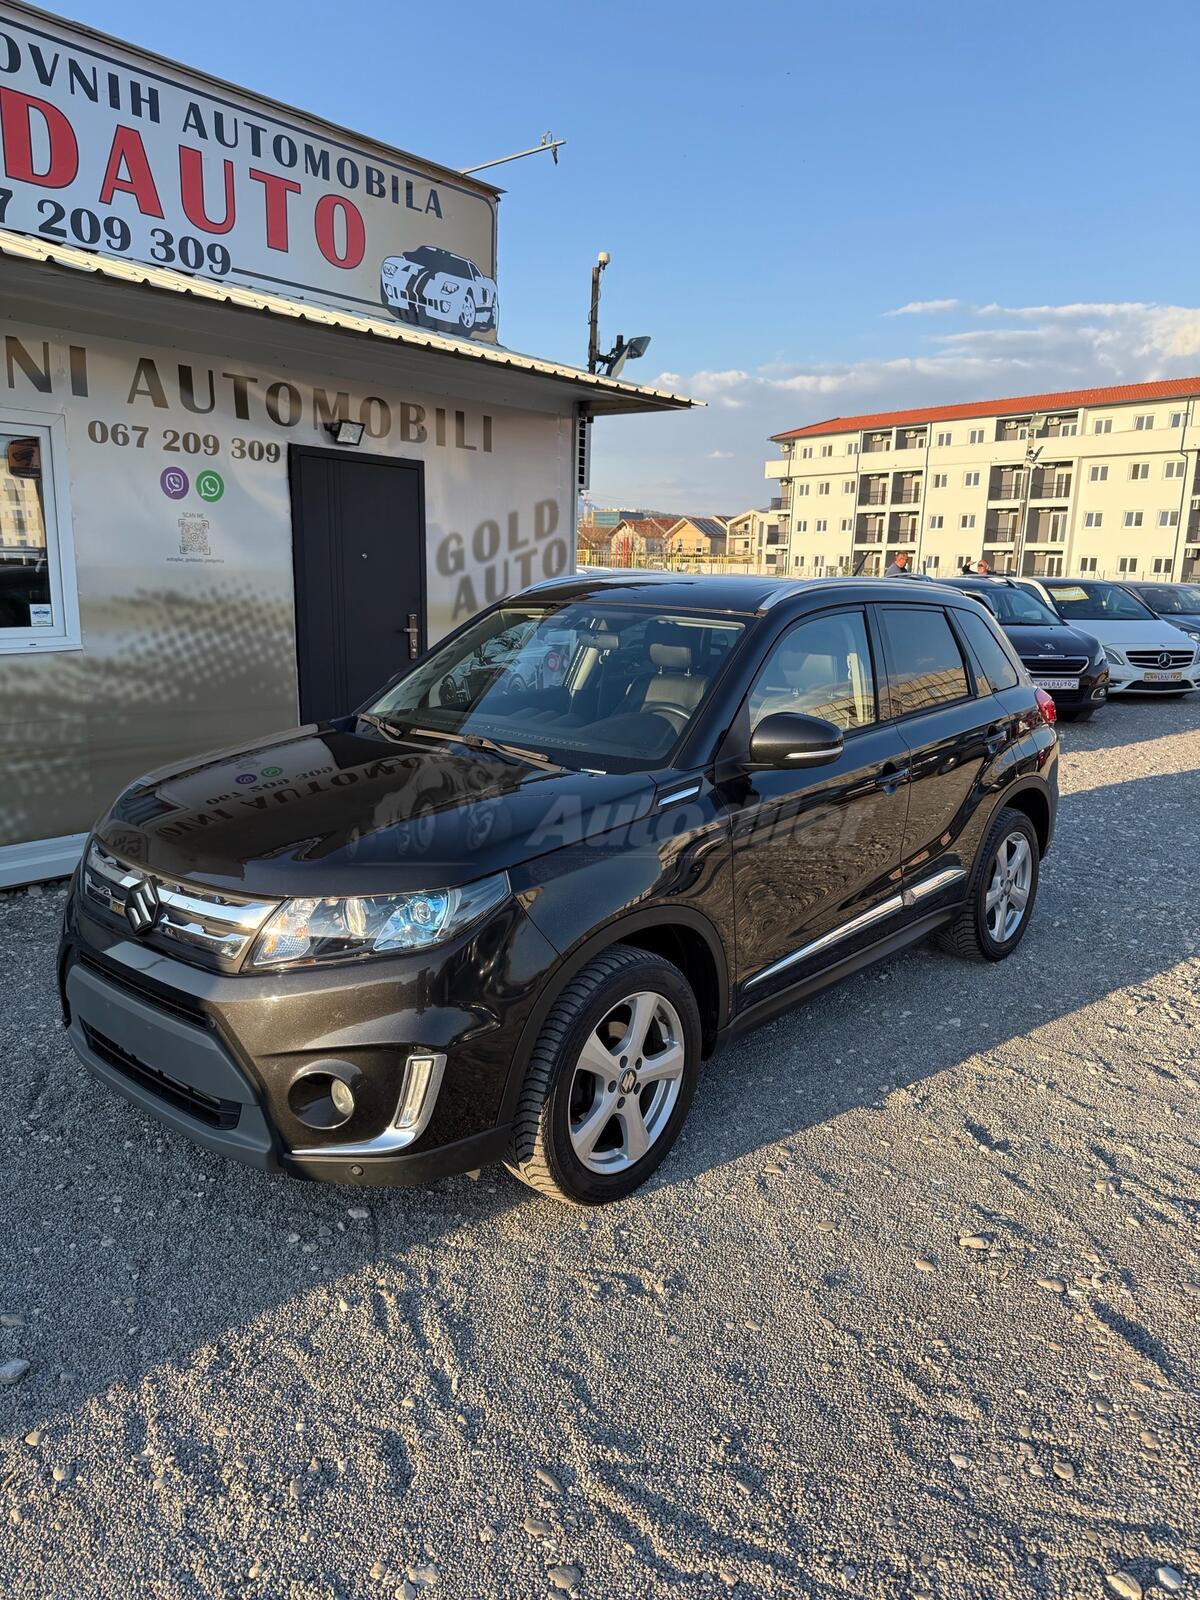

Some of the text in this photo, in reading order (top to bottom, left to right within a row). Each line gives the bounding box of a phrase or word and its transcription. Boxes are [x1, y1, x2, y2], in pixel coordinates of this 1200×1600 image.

[0, 32, 443, 219] OVNIH AUTOMOBILA
[0, 85, 366, 270] DAUTO
[37, 199, 131, 251] 209
[150, 228, 231, 276] 309
[5, 335, 492, 452] NI AUTOMOBILI
[88, 420, 281, 463] 067 209 309
[435, 497, 560, 577] GOLD
[451, 537, 567, 621] AUTO
